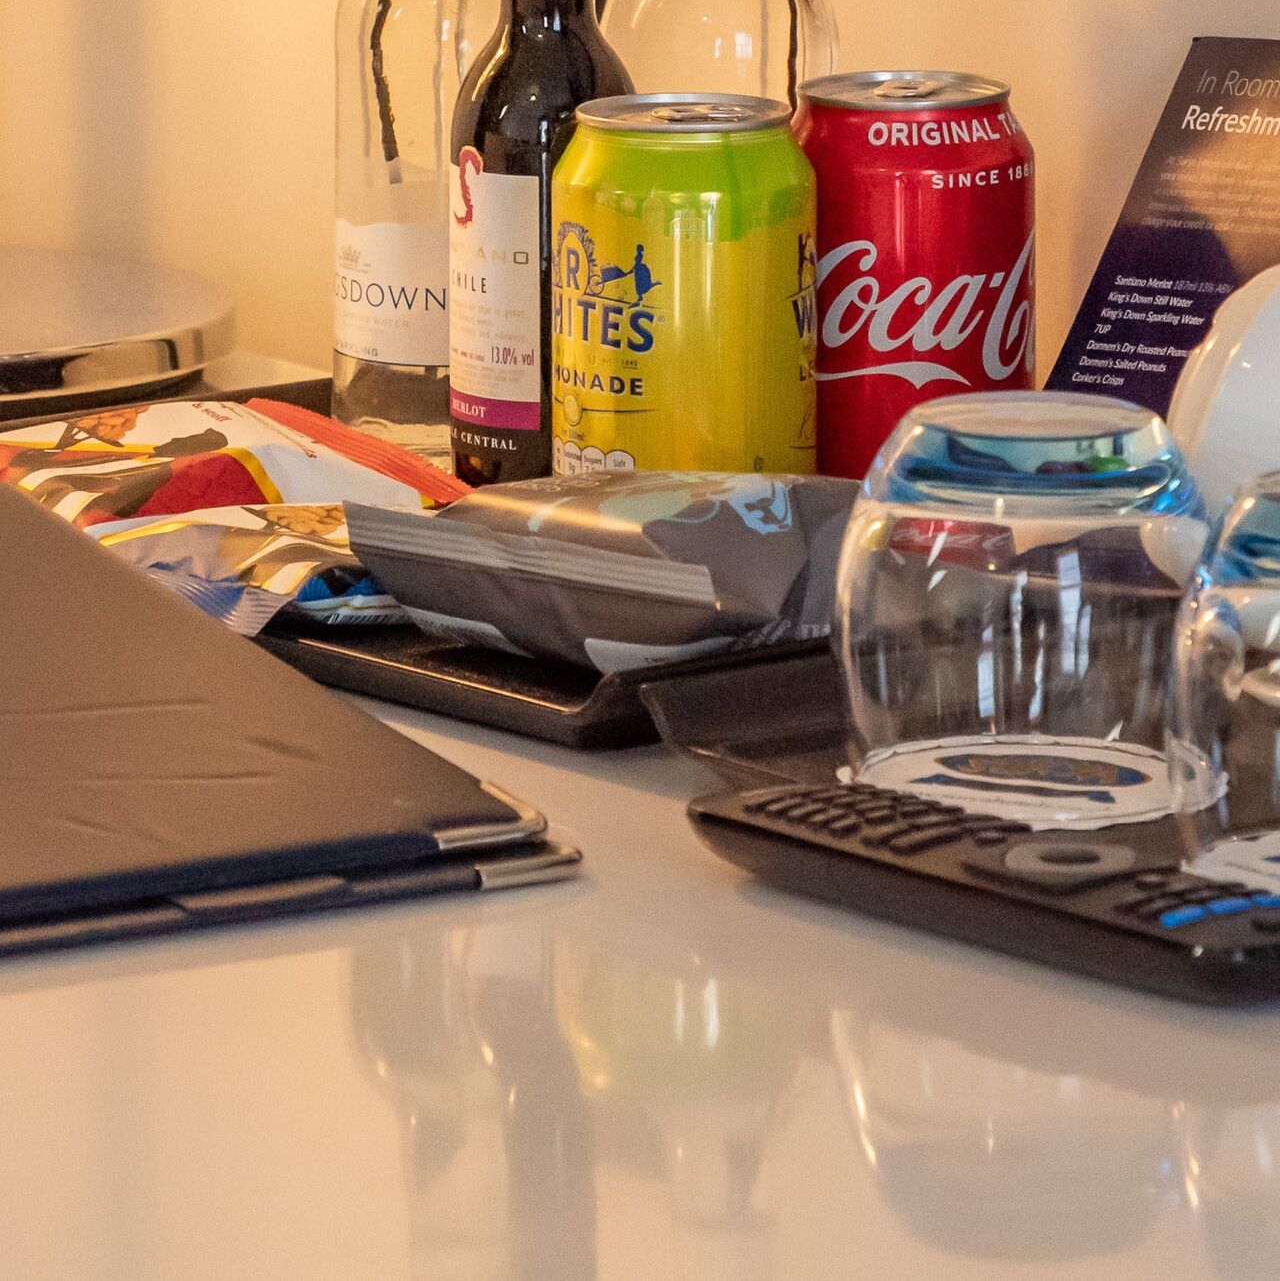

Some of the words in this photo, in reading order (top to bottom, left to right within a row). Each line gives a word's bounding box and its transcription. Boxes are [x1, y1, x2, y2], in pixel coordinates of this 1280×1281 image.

[1196, 69, 1218, 94] In
[868, 117, 1001, 146] ORIGINAL
[931, 169, 999, 190] SINCE
[566, 247, 580, 291] R
[1147, 277, 1173, 289] Merlot
[1108, 291, 1130, 304] King's
[1130, 293, 1153, 304] Down
[1154, 295, 1169, 306] Still
[1170, 296, 1193, 307] Water
[554, 288, 655, 353] HITES
[1101, 308, 1122, 320] King's
[1123, 309, 1146, 320] Down
[1146, 311, 1179, 325] Sparkling
[1181, 314, 1205, 326] Water
[1093, 323, 1111, 334] 7UP
[491, 345, 518, 366] 13.0%
[521, 349, 535, 366] vol
[1121, 342, 1136, 354] Dry
[1137, 343, 1167, 356] Roasted
[1114, 359, 1137, 370] Salted
[1138, 360, 1167, 372] Peanuts
[1072, 371, 1101, 383] Corker's
[1102, 374, 1125, 385] Crisps
[452, 398, 487, 418] MERLOT
[460, 431, 518, 451] CENTRAL
